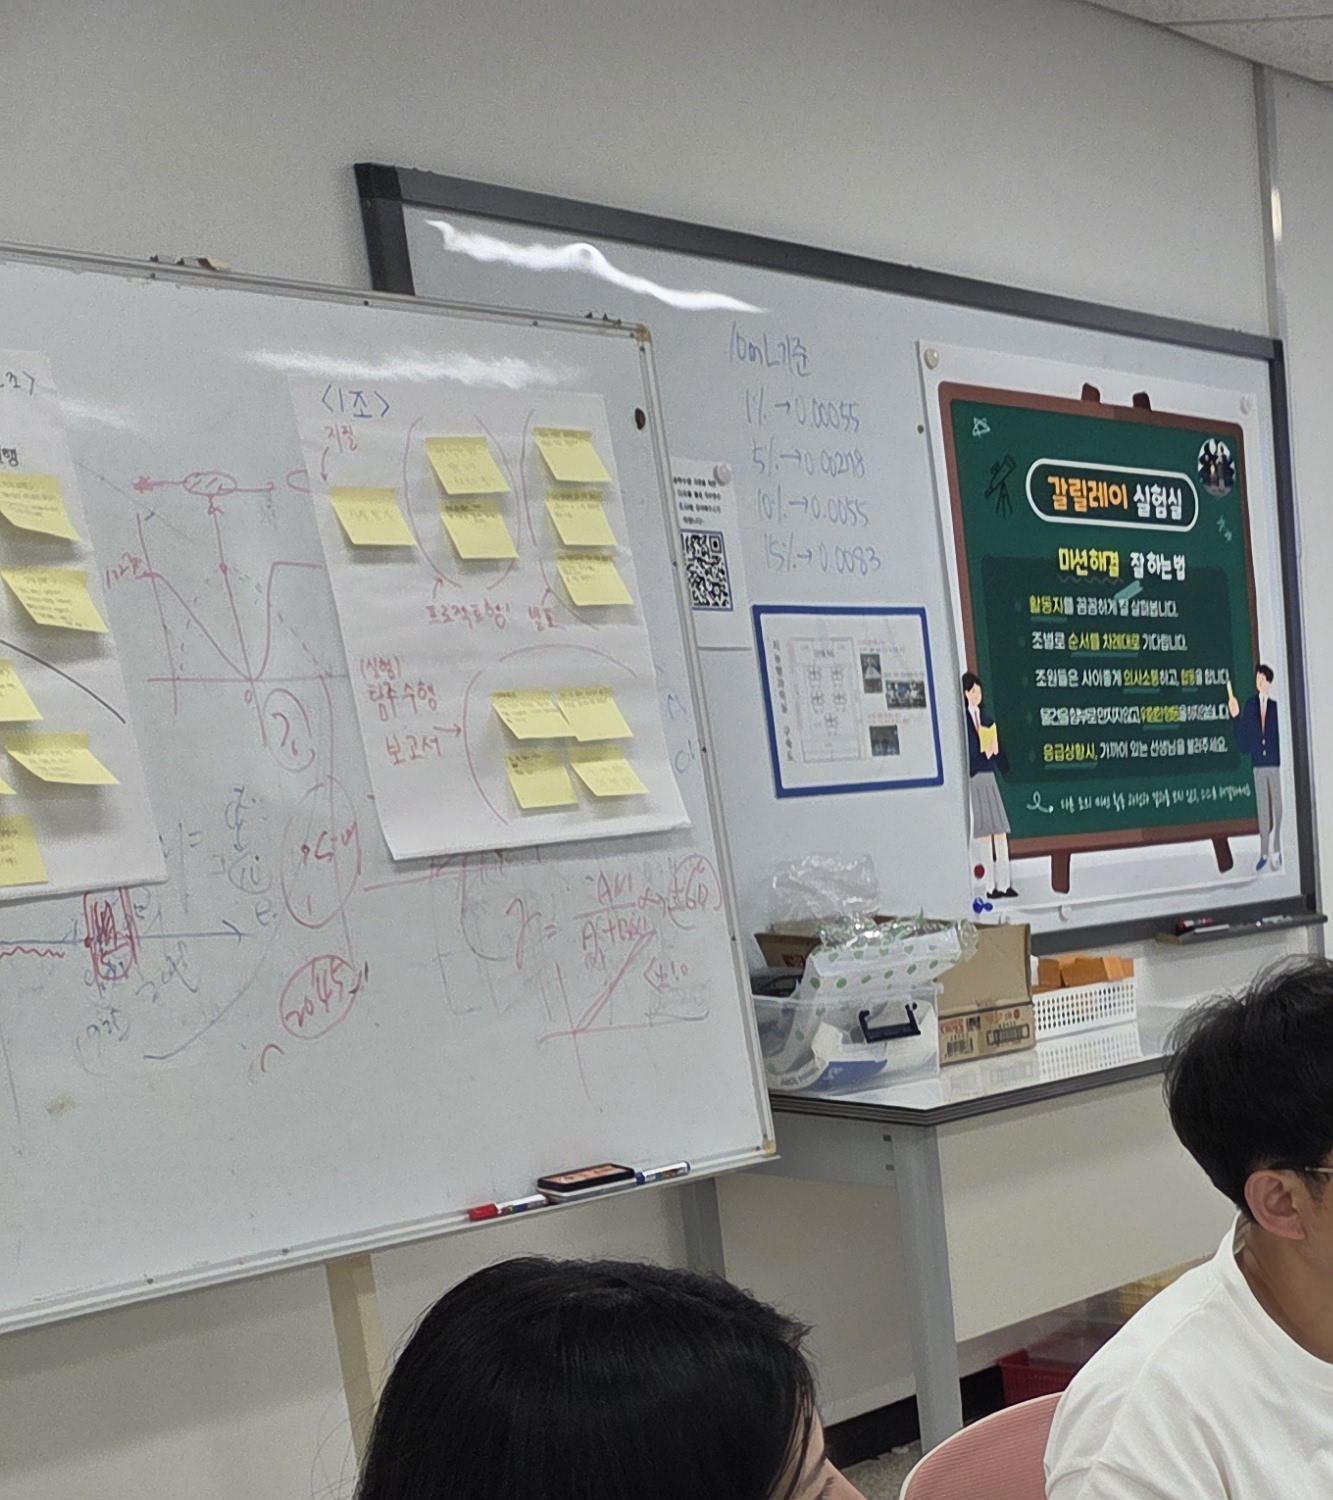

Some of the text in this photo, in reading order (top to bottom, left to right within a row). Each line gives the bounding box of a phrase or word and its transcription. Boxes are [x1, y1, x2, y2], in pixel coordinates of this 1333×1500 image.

[1048, 476, 1182, 520] 갈릴레이 실험실
[1058, 547, 1185, 581] 미션해결 잘 하는 법
[1031, 631, 1065, 650] 조별로
